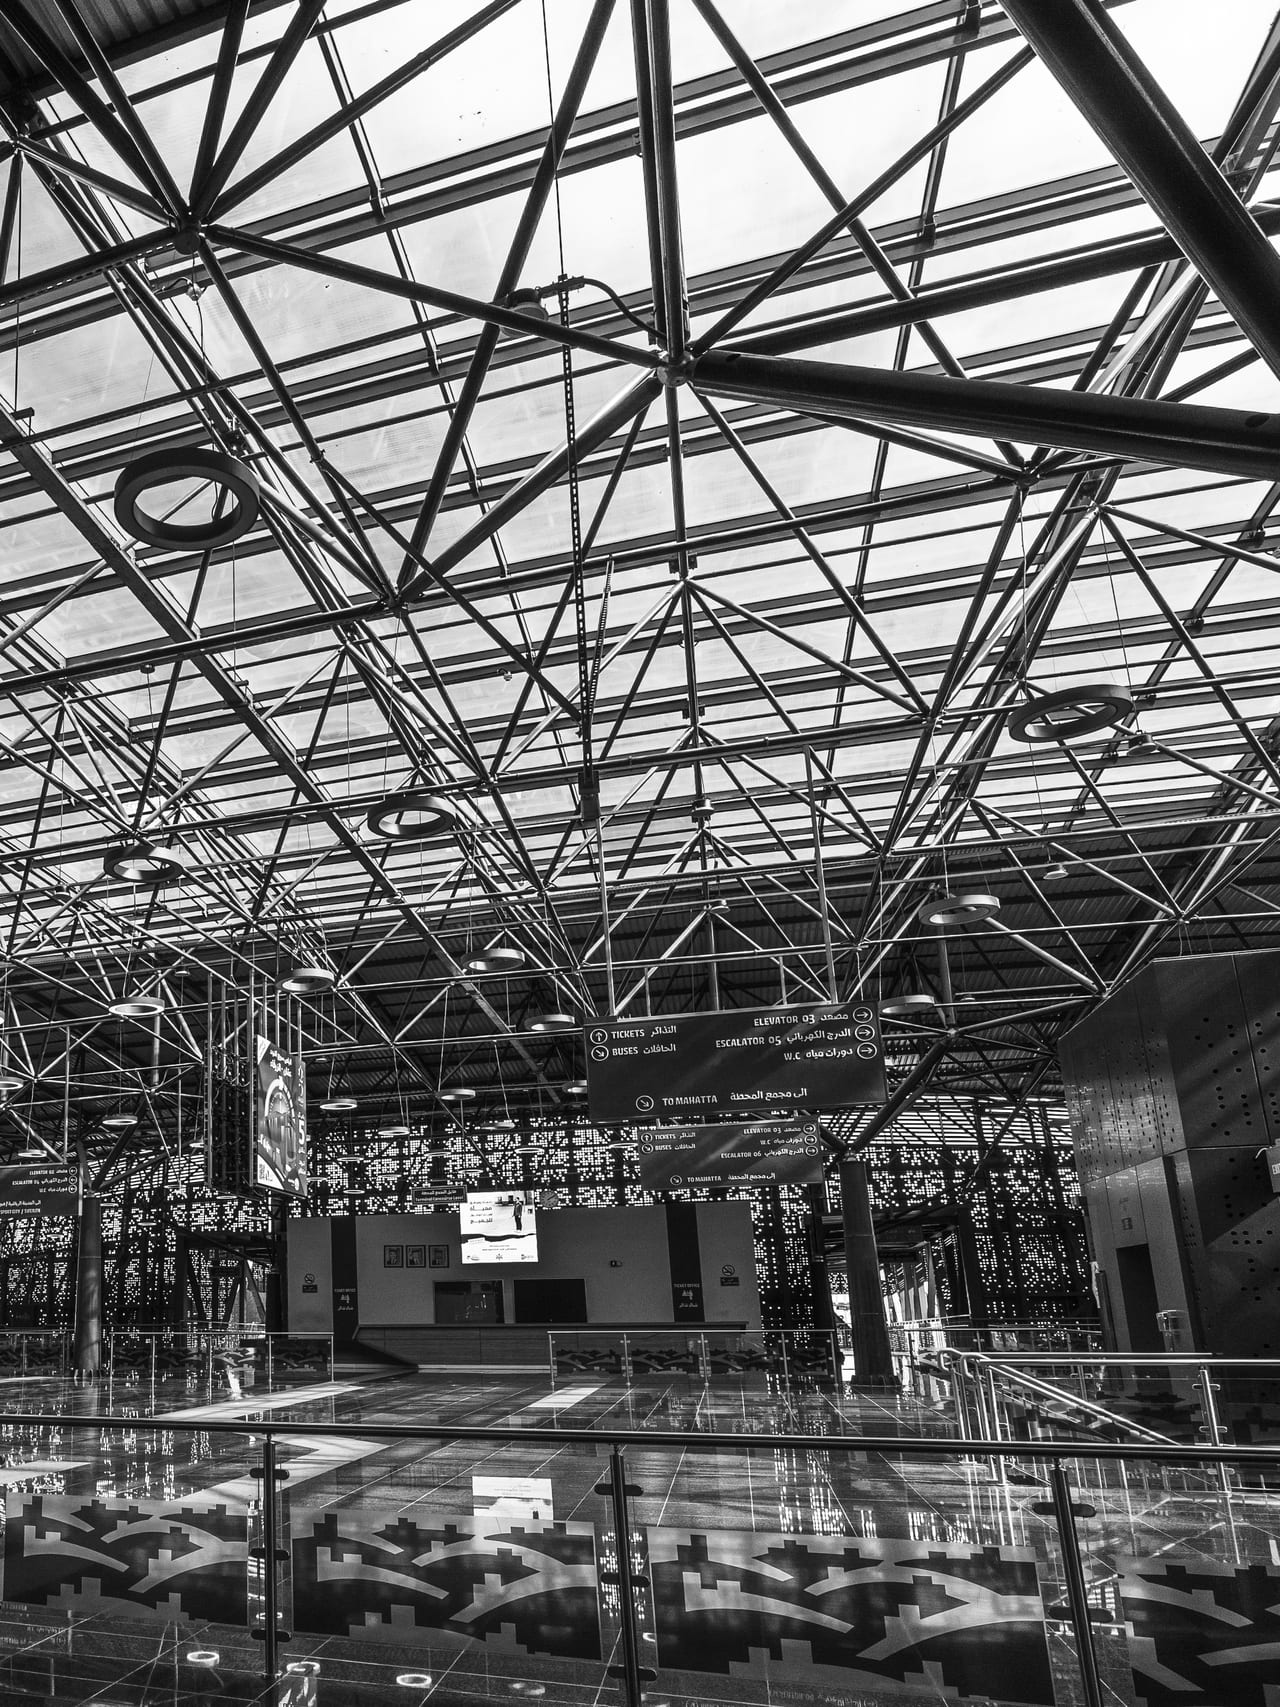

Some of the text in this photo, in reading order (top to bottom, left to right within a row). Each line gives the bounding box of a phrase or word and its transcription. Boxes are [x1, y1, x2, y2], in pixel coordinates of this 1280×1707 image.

[754, 1014, 816, 1026] ELEVATOR 03
[820, 1013, 848, 1021] مصعد
[611, 1029, 645, 1039] TICKETS
[650, 1025, 677, 1038] التذاكر
[786, 1028, 851, 1045] الدرج الكهربائي
[716, 1036, 782, 1048] ESCALATOR 05
[612, 1046, 638, 1056] BUSES
[643, 1043, 676, 1054] الحافلات
[806, 1048, 853, 1059] دورات مياه
[784, 1052, 800, 1060] W.C
[730, 1090, 763, 1100] المحطة
[765, 1091, 792, 1101] مجمع
[662, 1095, 718, 1106] TO MAHATTA
[744, 1127, 771, 1135] ELEVATOR
